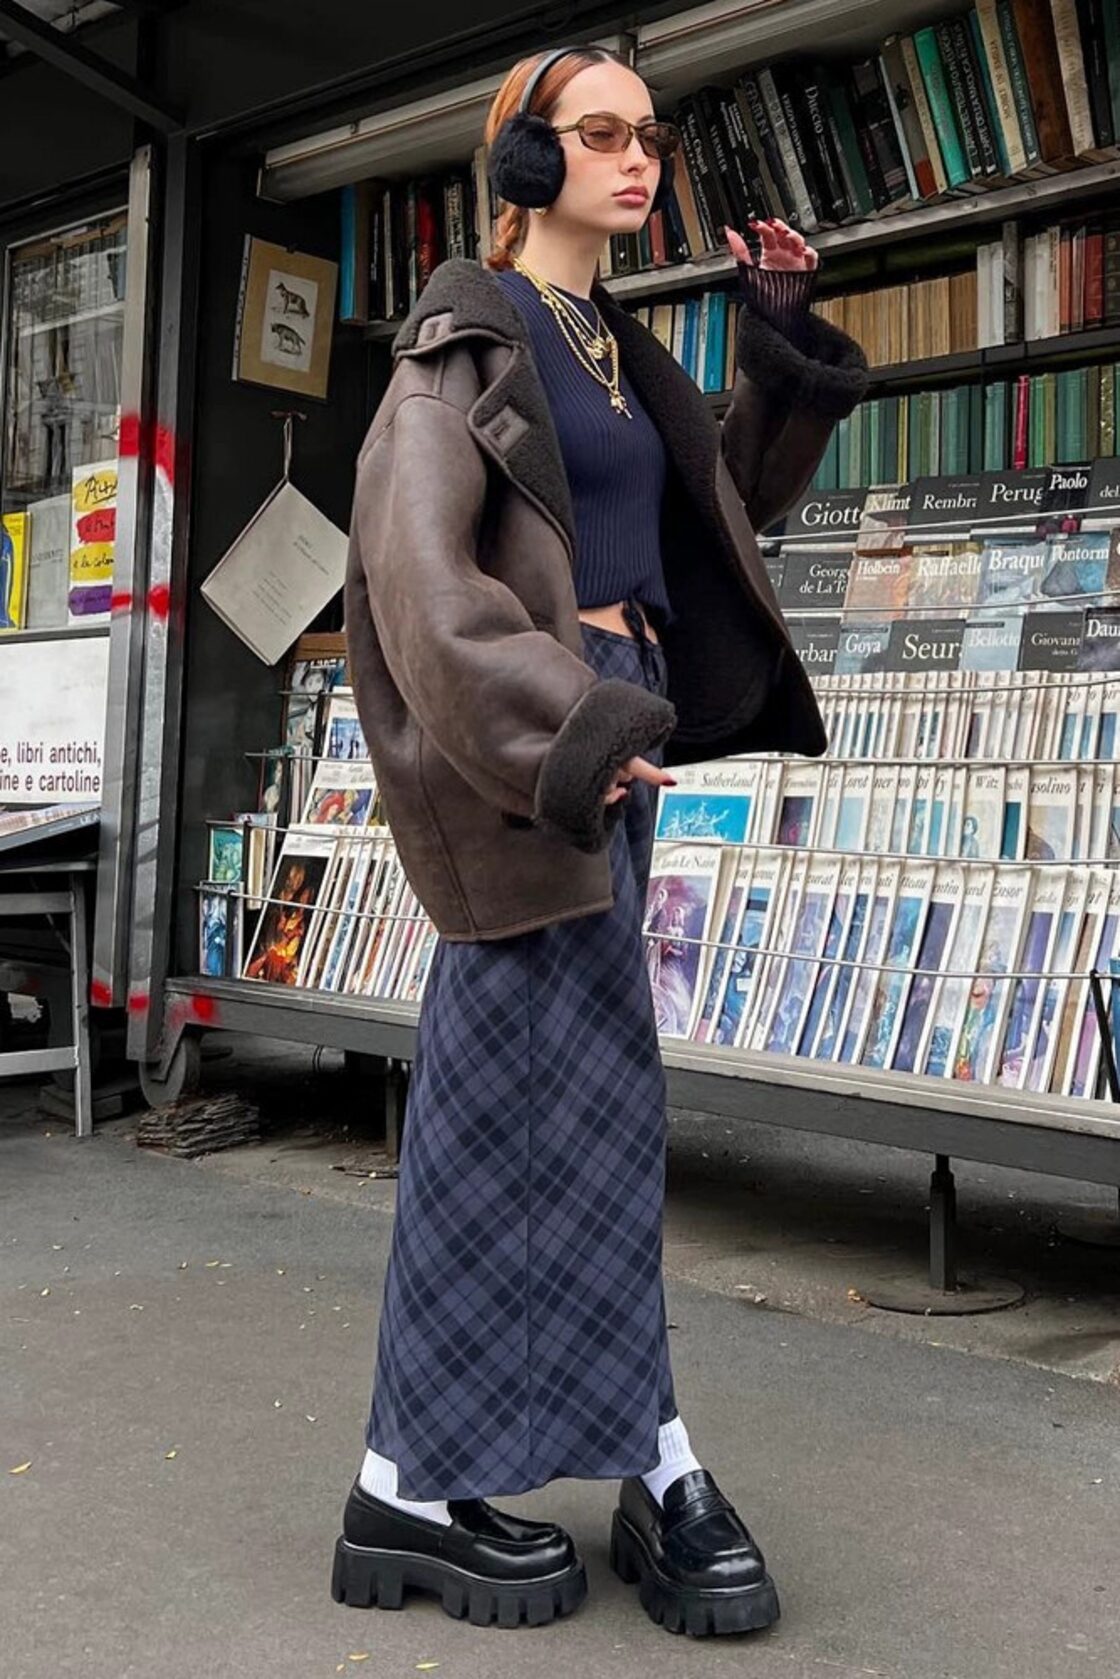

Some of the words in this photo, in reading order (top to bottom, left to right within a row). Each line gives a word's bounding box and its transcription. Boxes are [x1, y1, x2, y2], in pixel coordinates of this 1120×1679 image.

[804, 84, 827, 134] Duccio
[691, 137, 711, 175] Chagall
[1049, 472, 1088, 491] Paolo
[799, 581, 813, 593] de
[845, 633, 881, 658] Goya
[17, 741, 44, 763] libri
[50, 741, 102, 767] antichi,
[25, 774, 33, 791] e
[39, 770, 100, 792] cartoline
[701, 772, 756, 788] Sutherland
